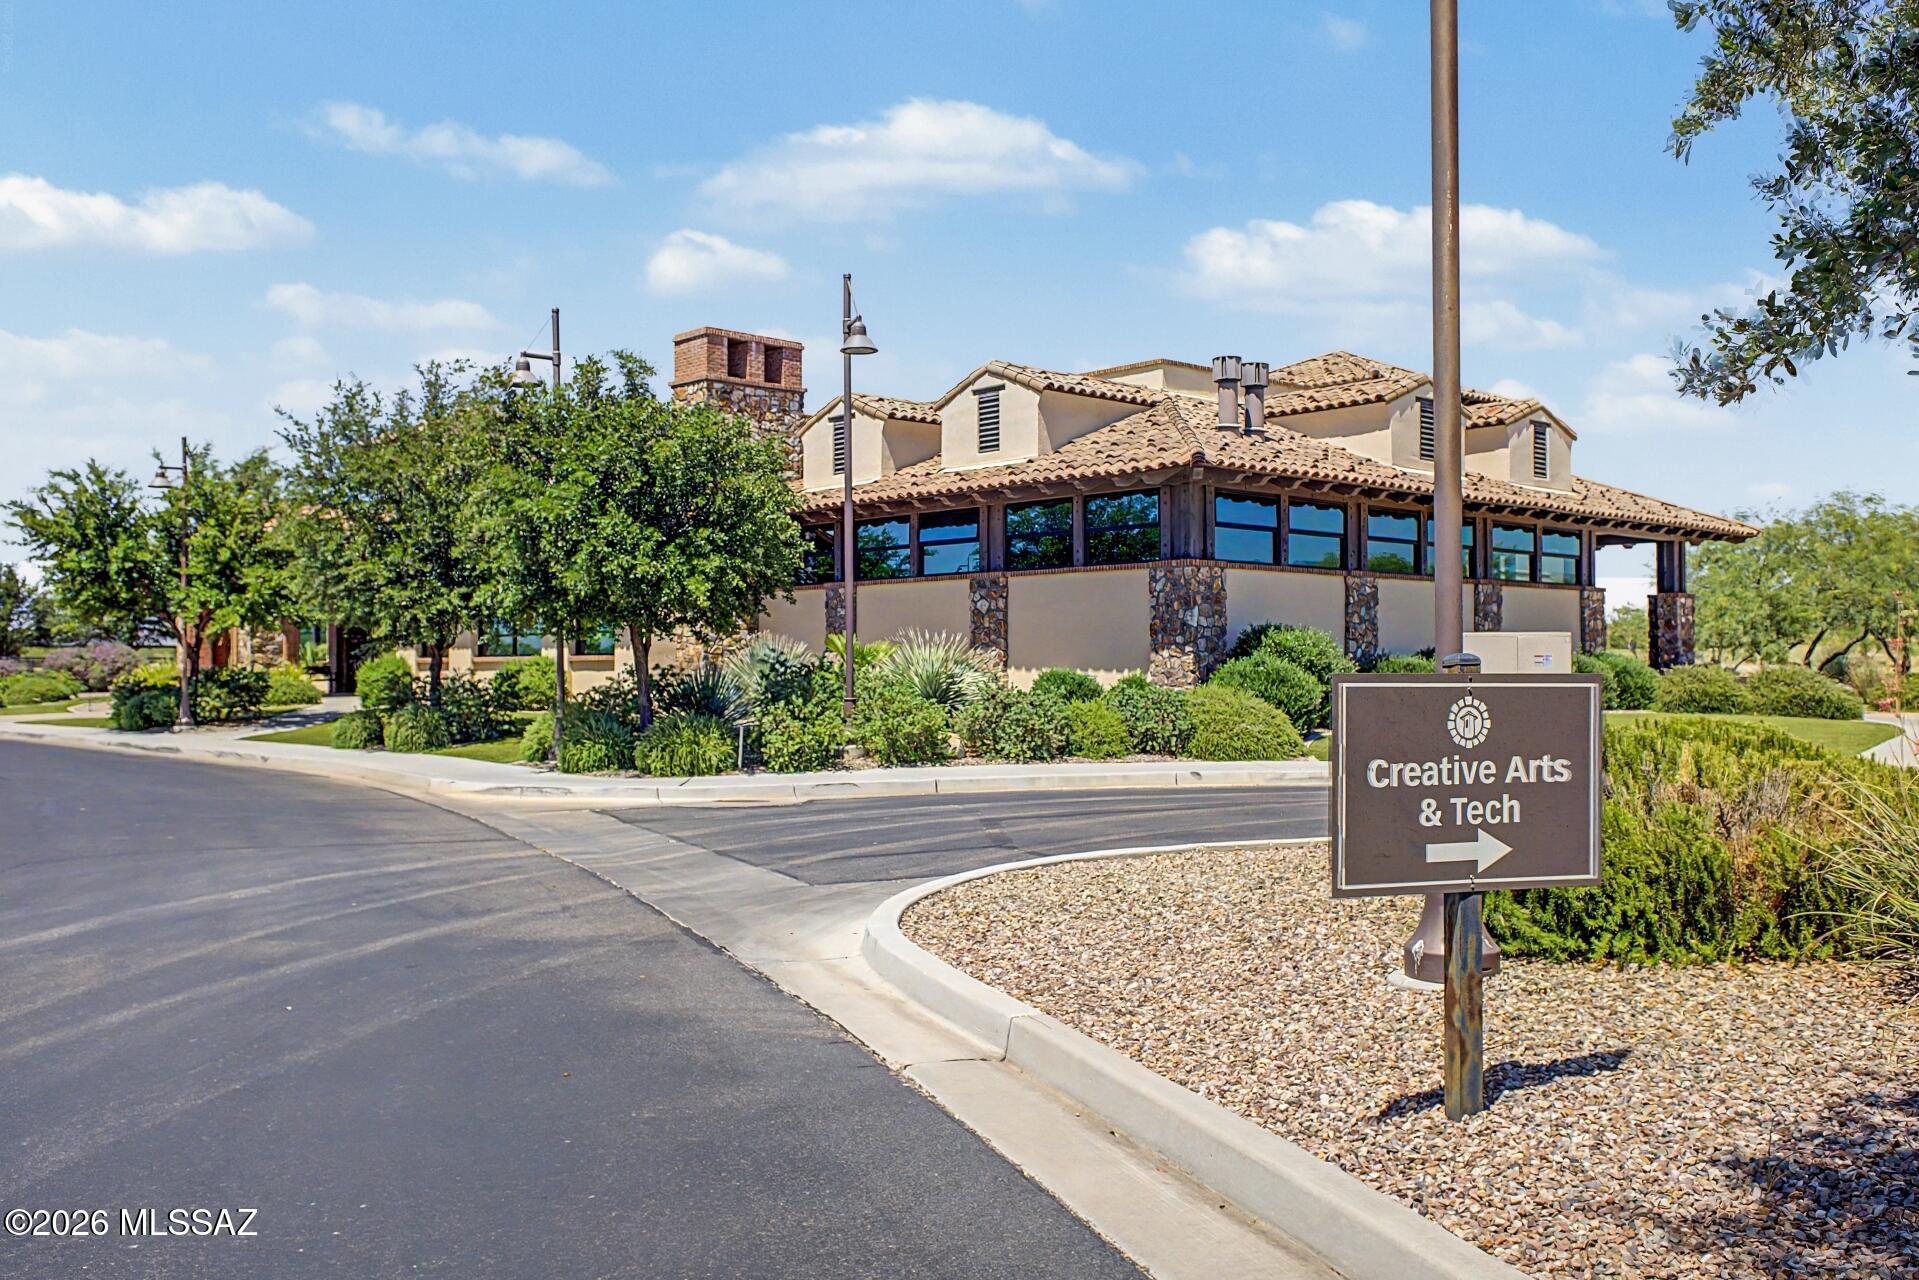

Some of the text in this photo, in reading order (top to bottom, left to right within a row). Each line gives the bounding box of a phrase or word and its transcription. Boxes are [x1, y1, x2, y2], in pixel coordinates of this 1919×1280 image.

[1367, 754, 1573, 788] Creative Arts
[1419, 794, 1521, 827] & Tech
